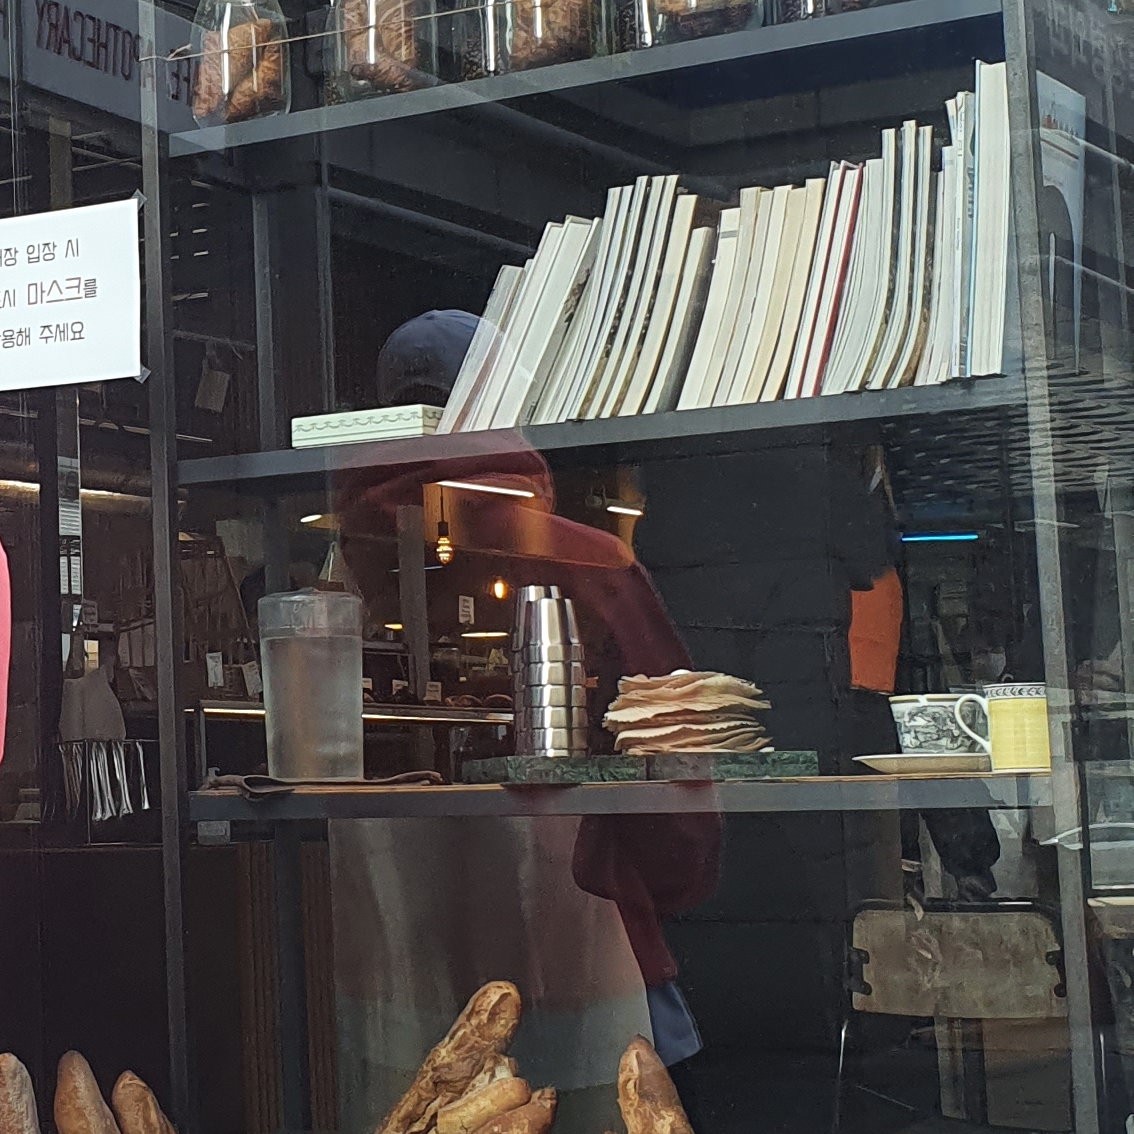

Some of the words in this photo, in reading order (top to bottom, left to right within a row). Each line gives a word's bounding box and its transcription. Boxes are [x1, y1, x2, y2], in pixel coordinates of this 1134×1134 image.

[26, 241, 57, 264] 입장
[65, 238, 79, 258] 시
[27, 277, 98, 306] 마스크를
[38, 321, 85, 344] 주세요
